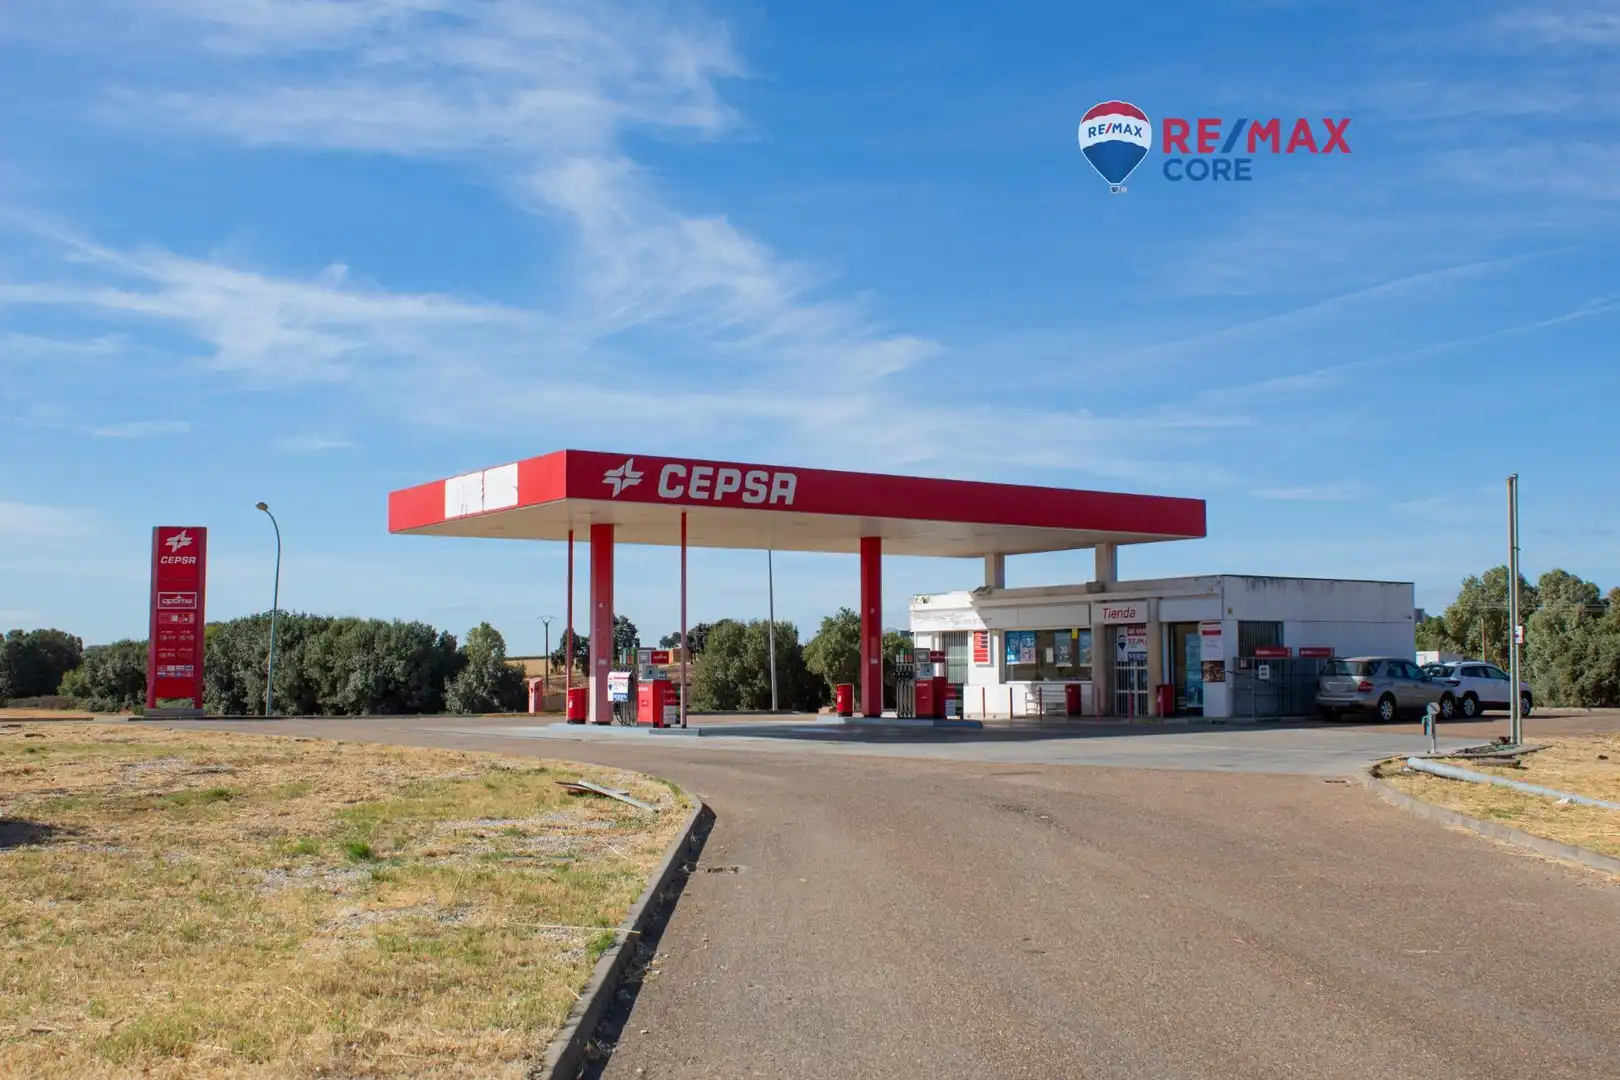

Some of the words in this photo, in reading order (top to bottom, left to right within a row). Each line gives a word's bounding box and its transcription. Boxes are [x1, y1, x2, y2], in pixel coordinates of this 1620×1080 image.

[657, 463, 798, 505] CEPSA
[160, 556, 197, 564] CEPSA
[1102, 607, 1136, 620] Tienda
